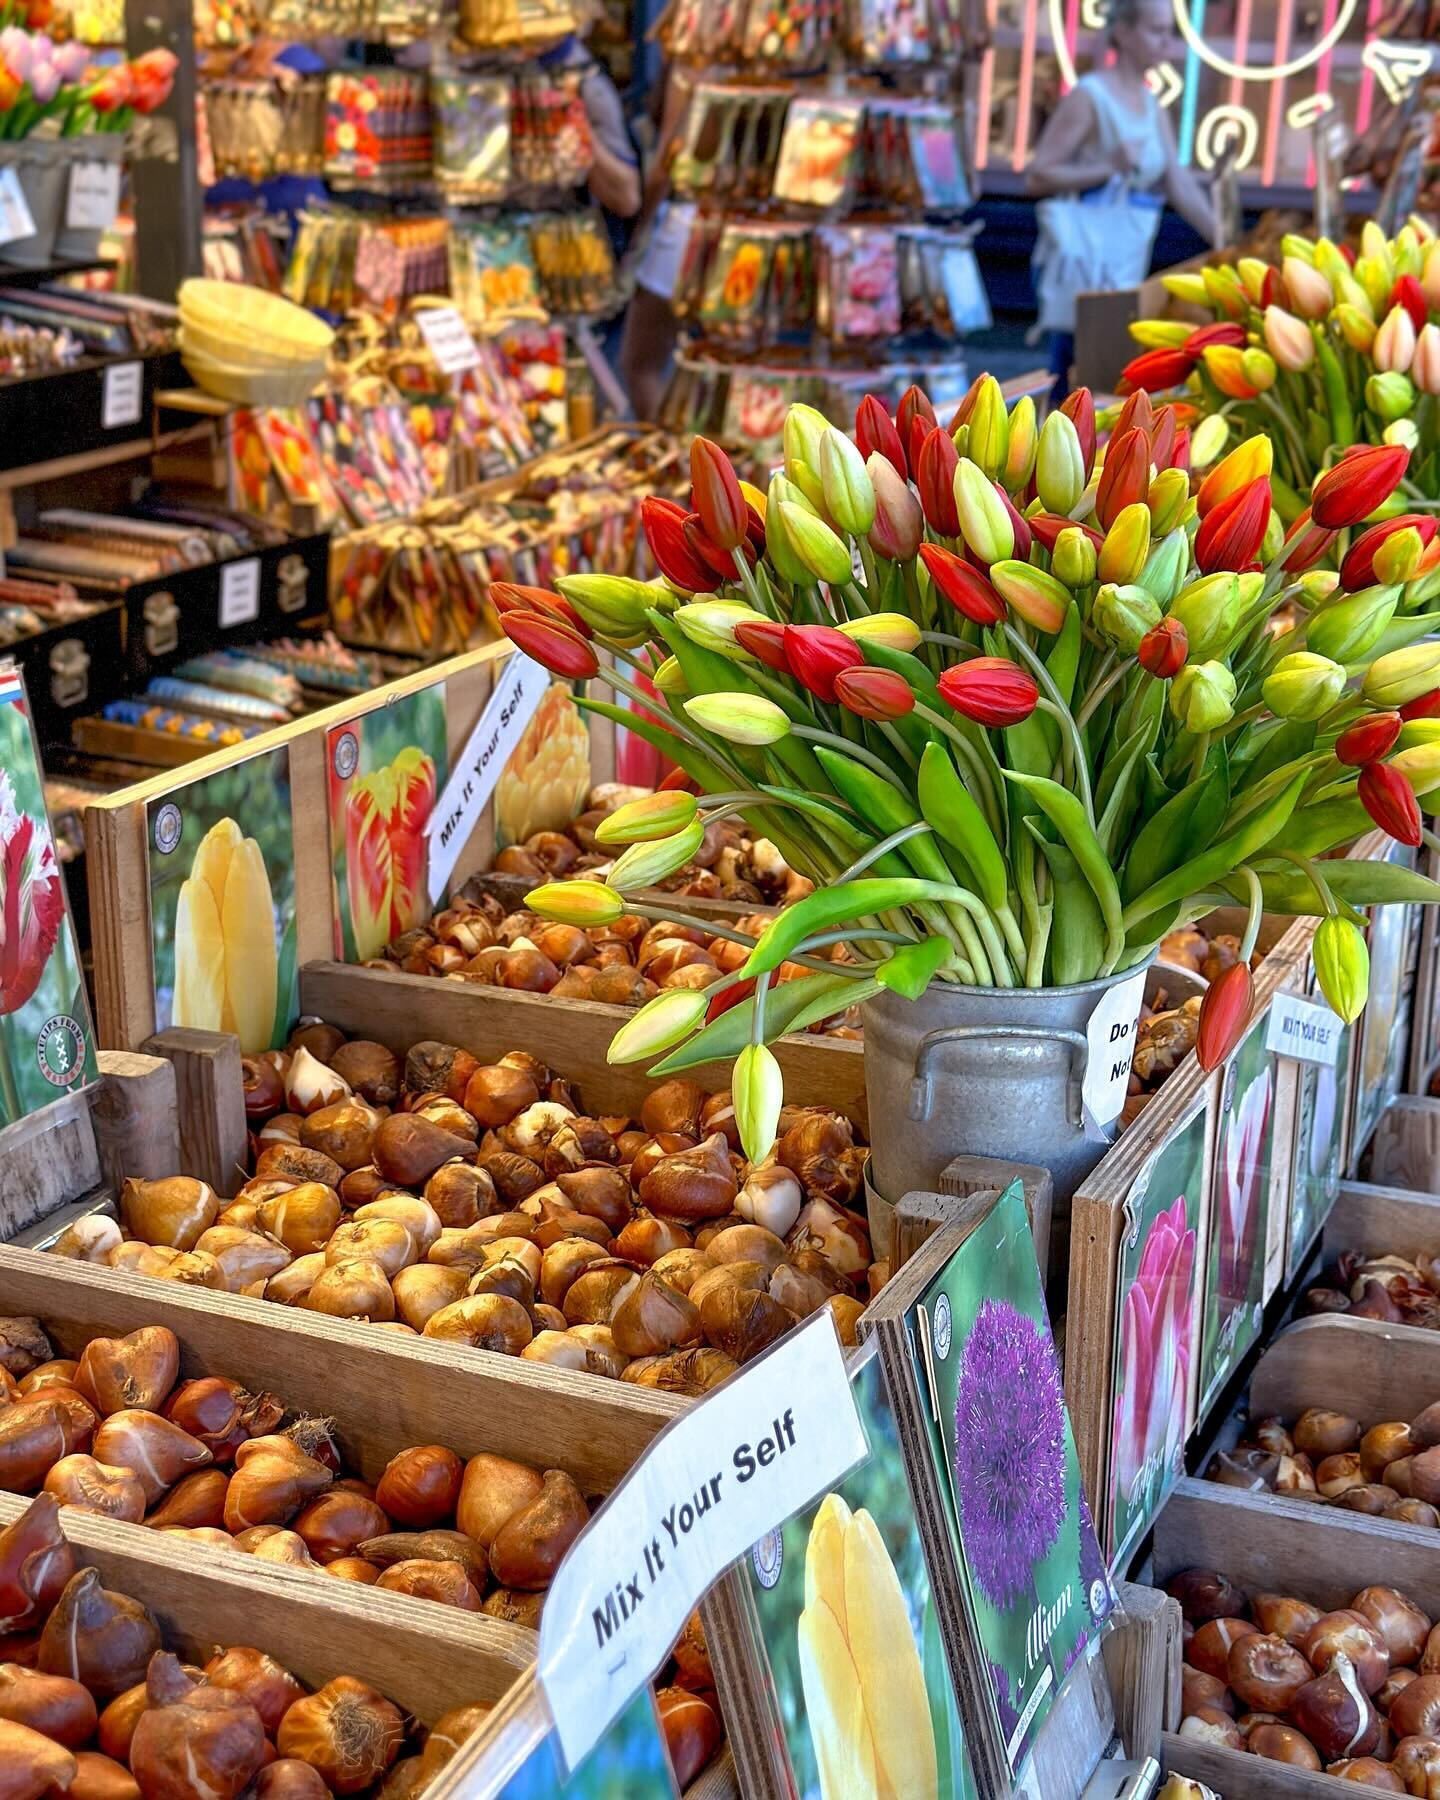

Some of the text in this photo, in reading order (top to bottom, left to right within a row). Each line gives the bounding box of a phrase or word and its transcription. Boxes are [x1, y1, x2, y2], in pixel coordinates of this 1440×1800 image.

[440, 680, 525, 848] Mix It Your Self
[38, 1018, 58, 1055] TULIPS
[60, 1017, 82, 1039] FROM
[1110, 1023, 1129, 1043] Do
[591, 1572, 645, 1649] Mix
[642, 1535, 665, 1584] It
[660, 1472, 723, 1549] Your
[732, 1408, 797, 1483] Self
[1018, 1584, 1074, 1688] Allium
